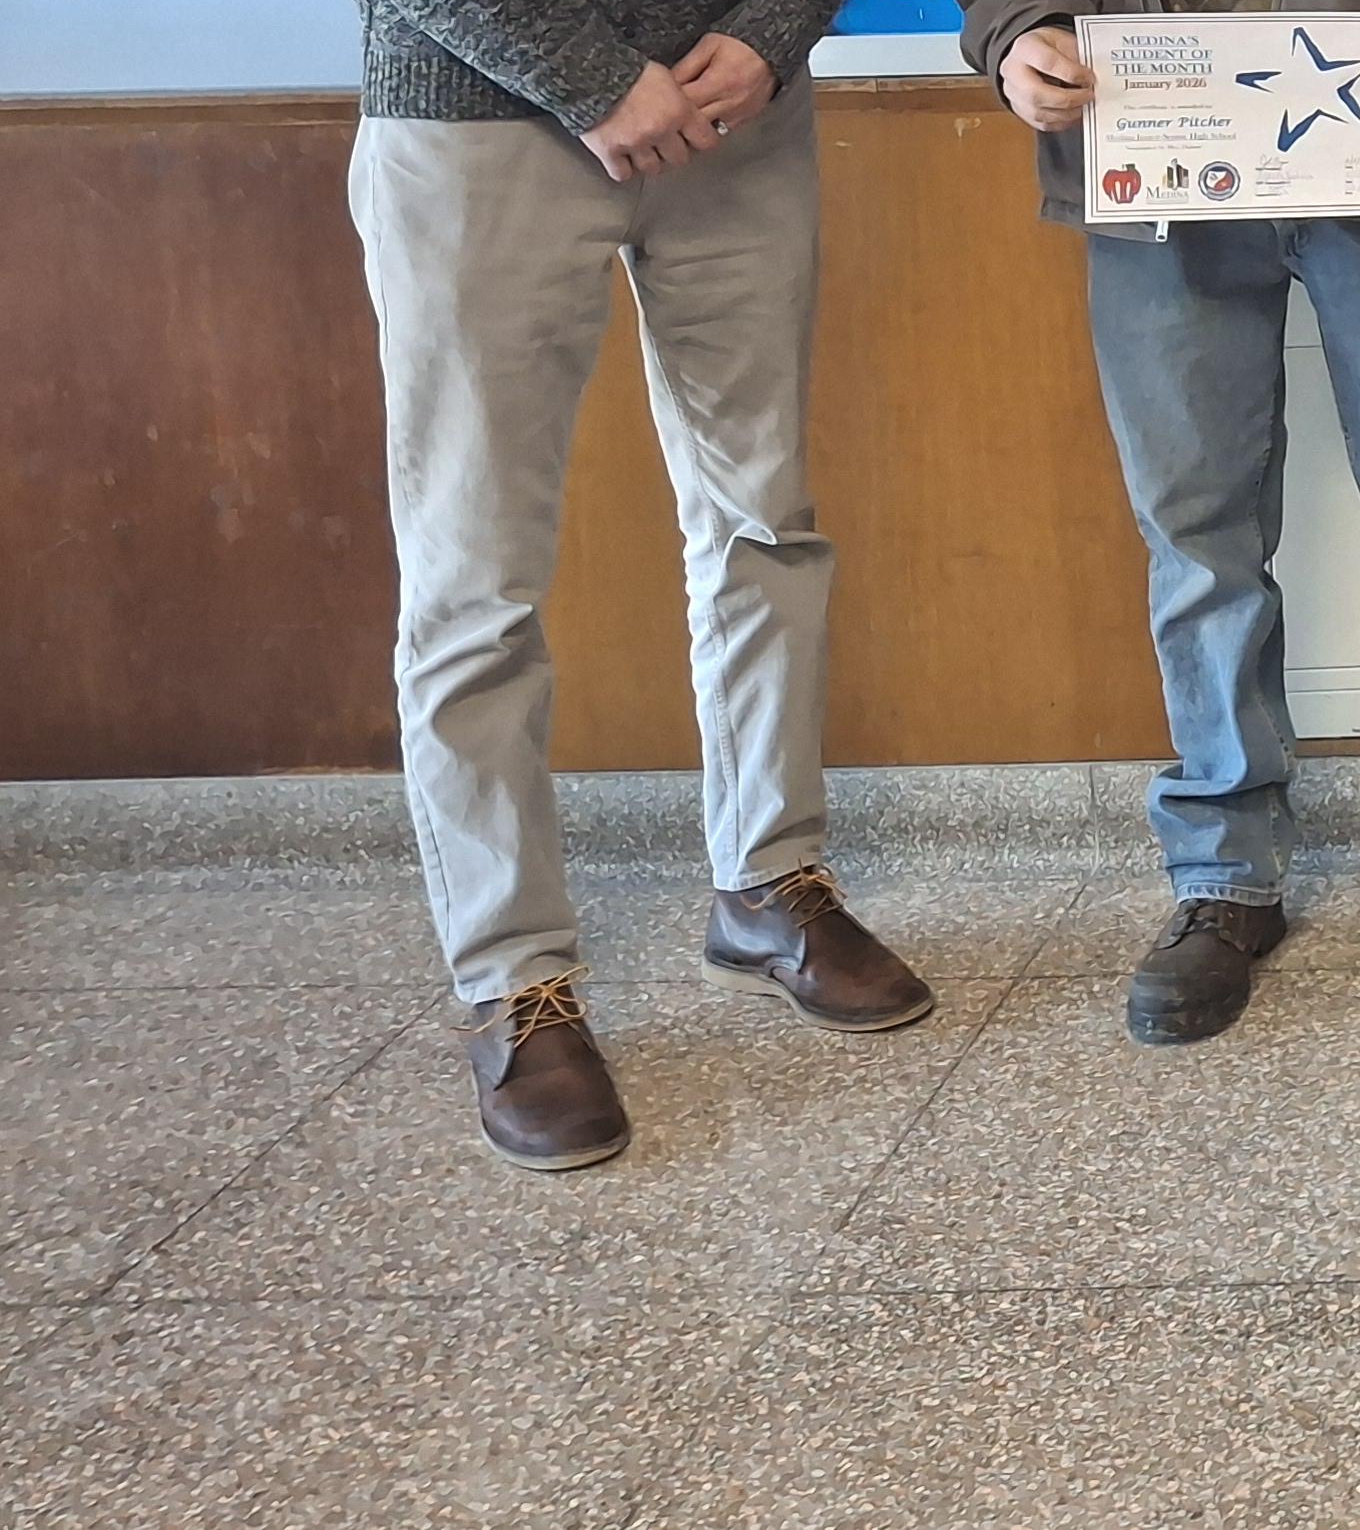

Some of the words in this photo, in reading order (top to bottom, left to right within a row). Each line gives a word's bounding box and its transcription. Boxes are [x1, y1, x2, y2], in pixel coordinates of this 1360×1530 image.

[1122, 35, 1199, 46] MEDINA'S
[1111, 49, 1187, 60] STUDENT
[1191, 49, 1213, 60] OF
[1112, 63, 1147, 74] THE
[1150, 63, 1213, 74] MONTH
[1125, 79, 1172, 91] January
[1176, 77, 1207, 89] 2026
[1117, 117, 1173, 131] Gunner
[1178, 115, 1232, 128] Pitcher
